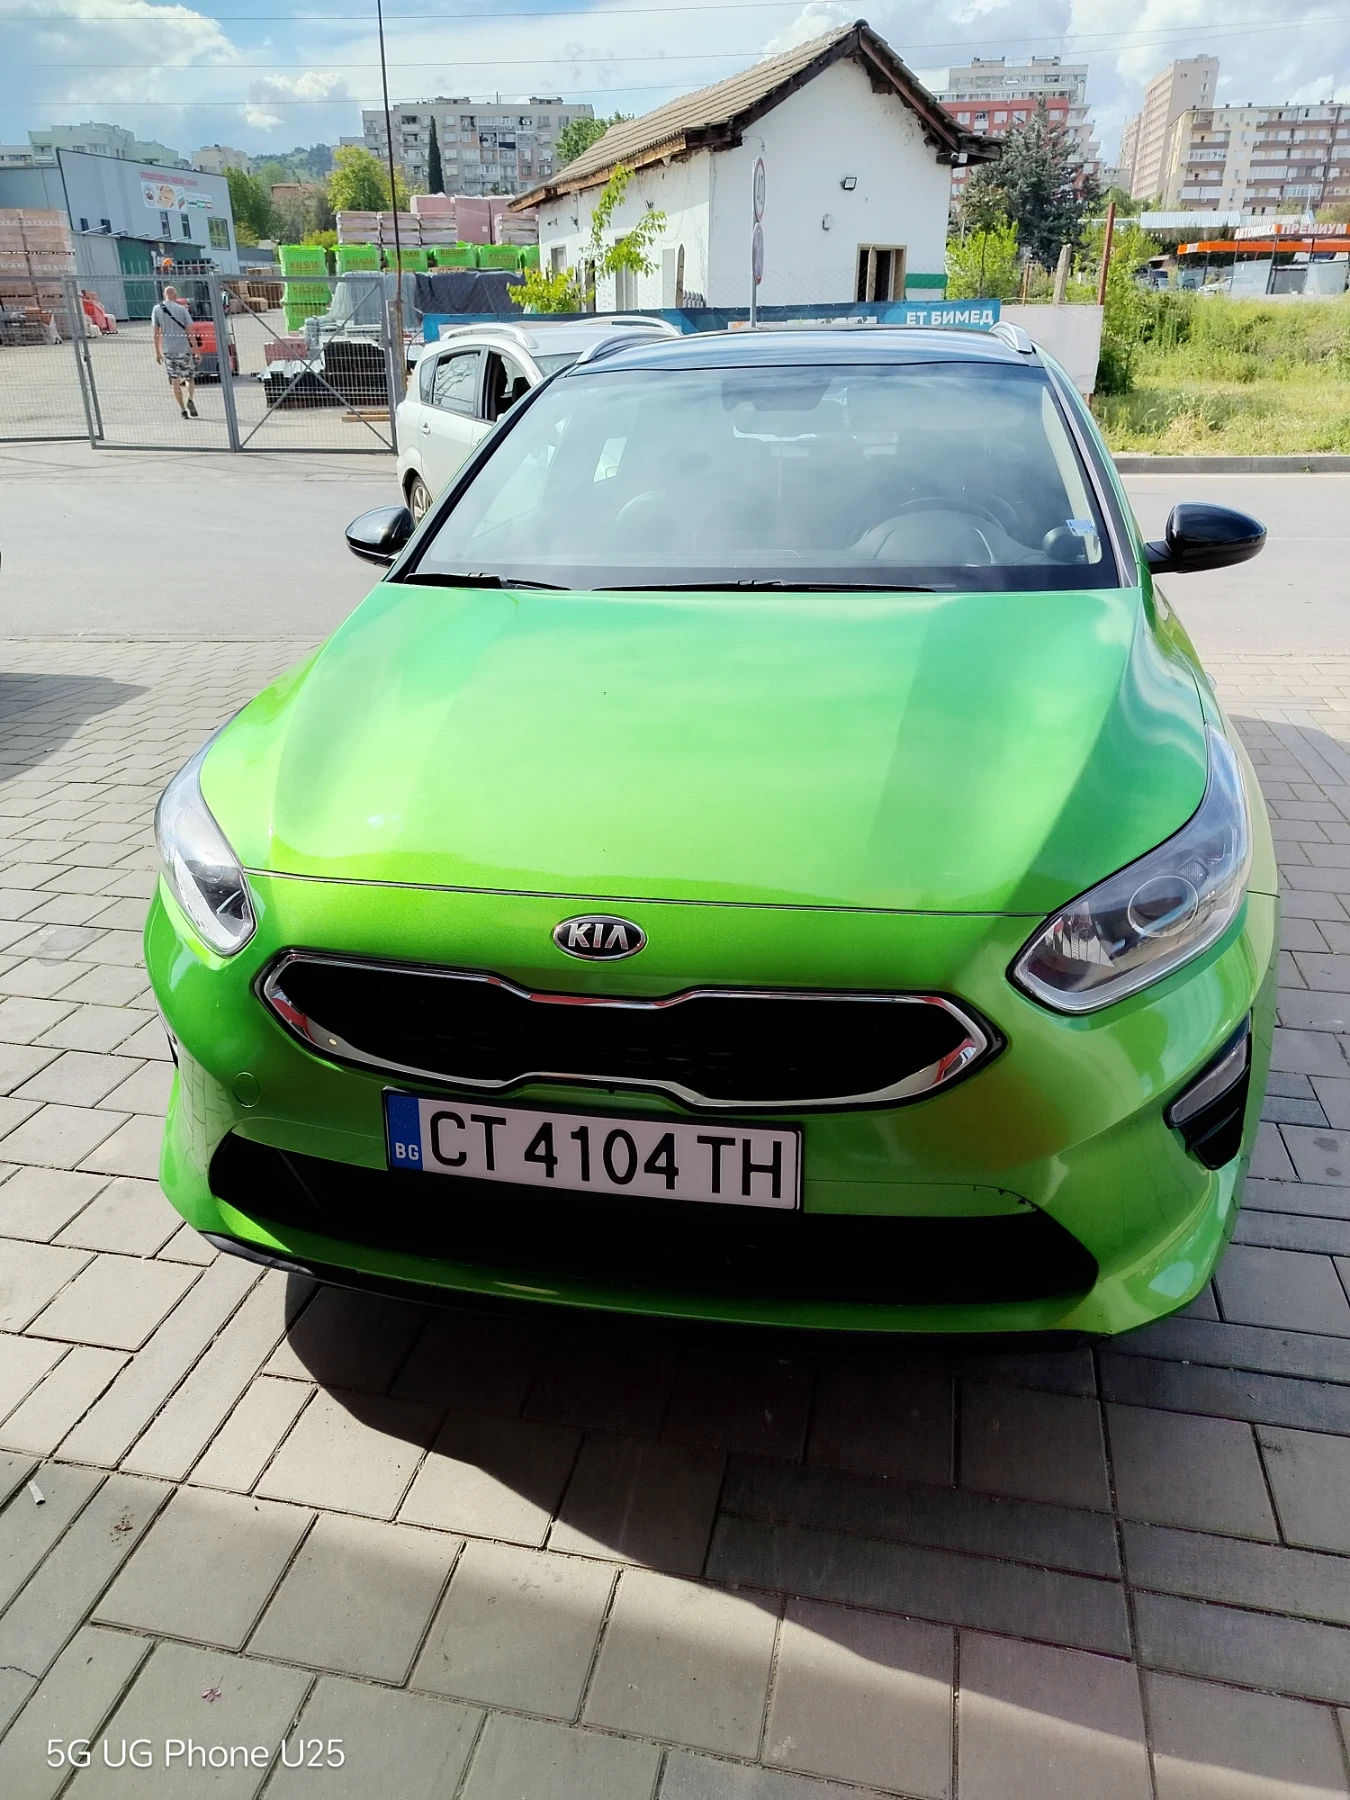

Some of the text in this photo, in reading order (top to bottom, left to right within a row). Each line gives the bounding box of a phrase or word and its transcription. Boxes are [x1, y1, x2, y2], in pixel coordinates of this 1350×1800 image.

[1280, 223, 1347, 234] ПРЕМИУМ
[907, 310, 994, 325] ЕТ БИМЕД
[567, 923, 629, 949] KIA
[395, 1142, 420, 1161] BG
[430, 1110, 782, 1199] CT 4104 TH
